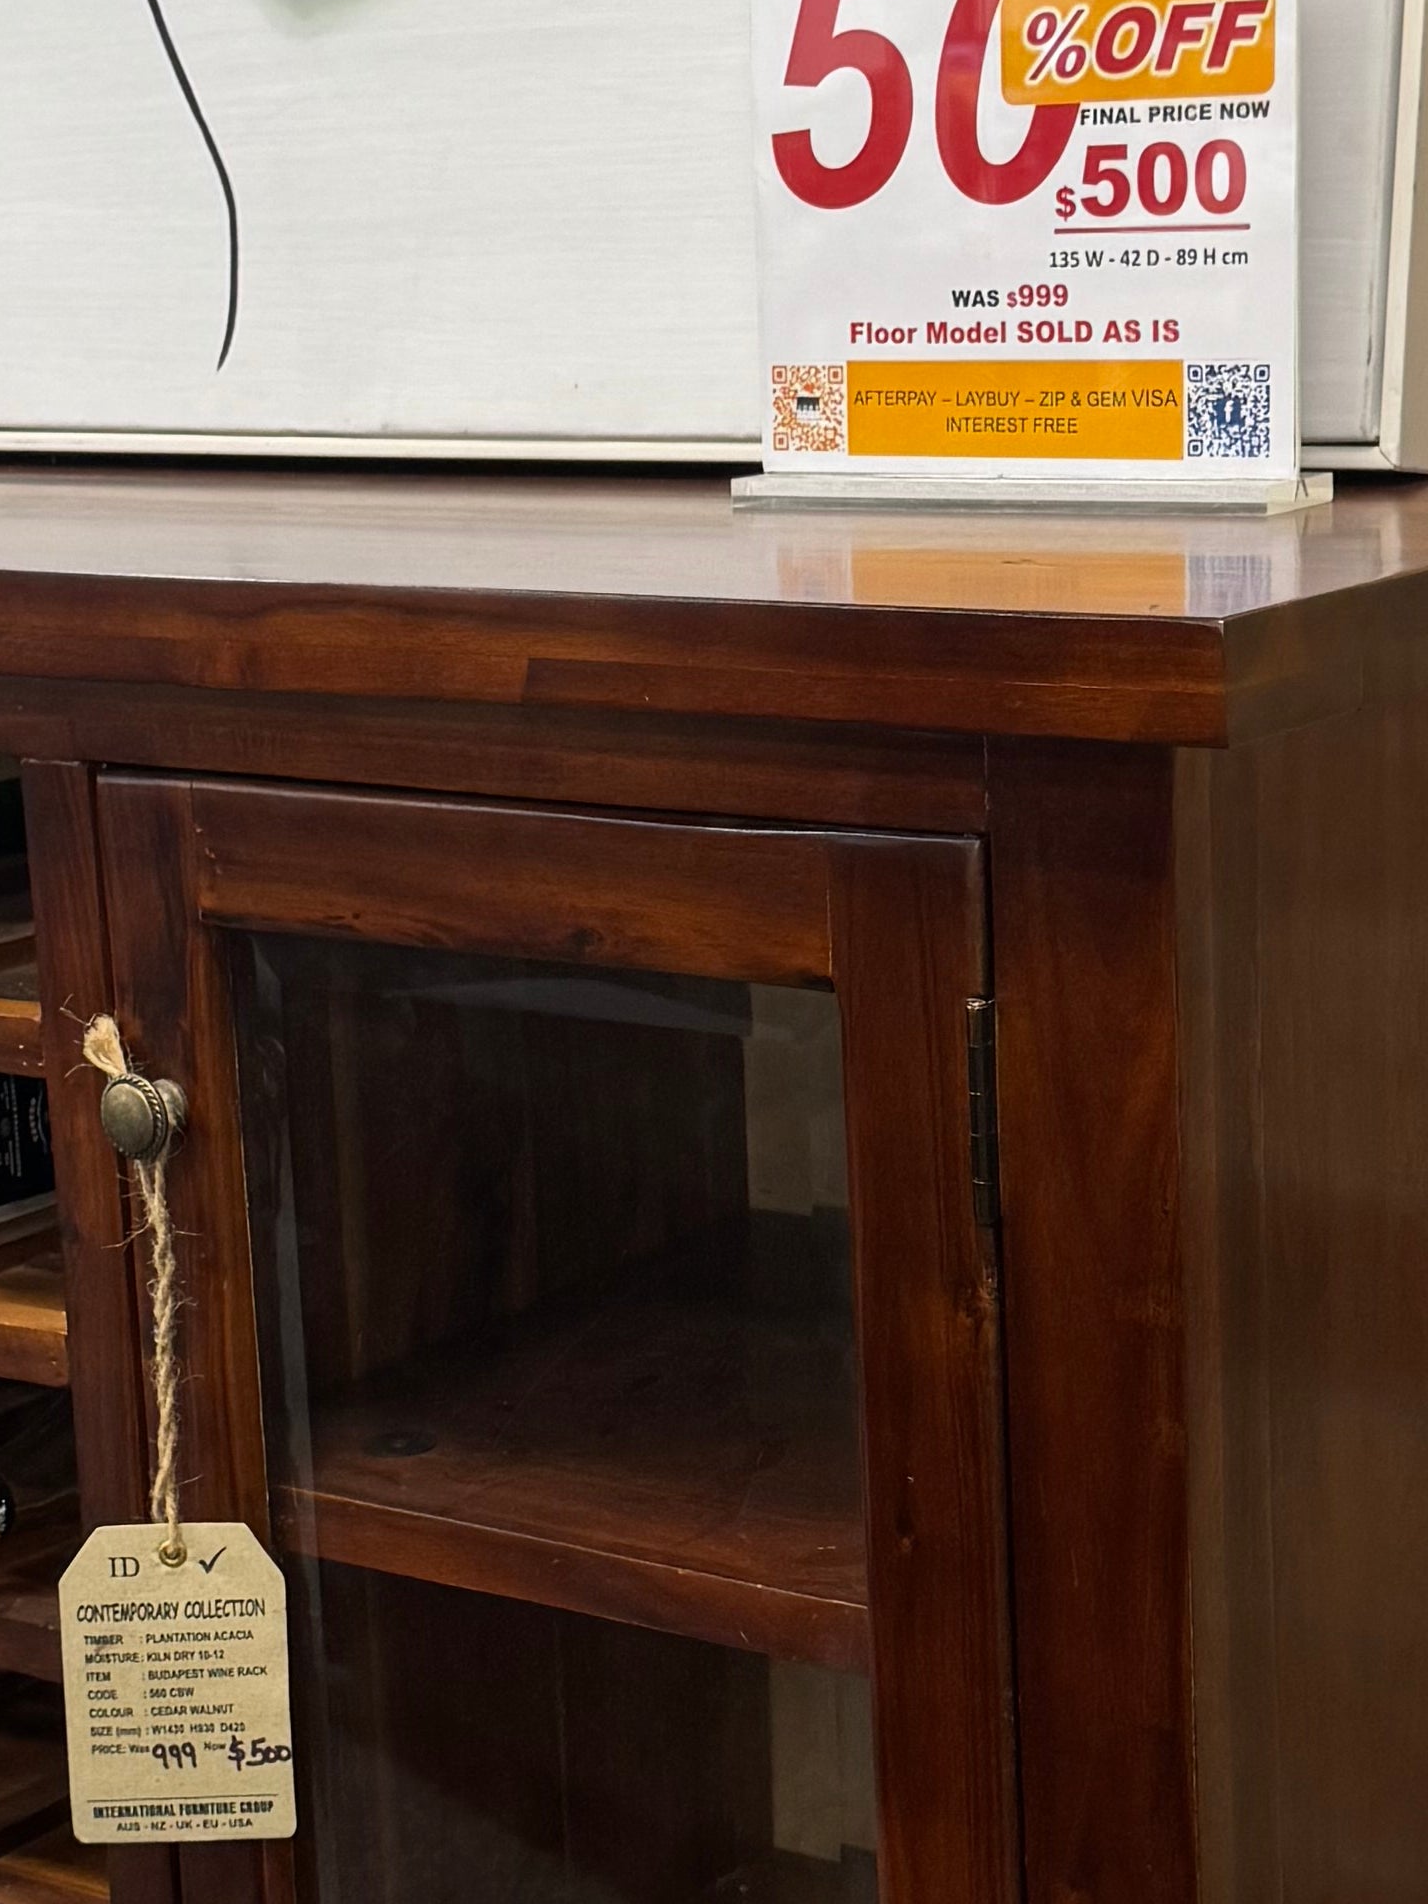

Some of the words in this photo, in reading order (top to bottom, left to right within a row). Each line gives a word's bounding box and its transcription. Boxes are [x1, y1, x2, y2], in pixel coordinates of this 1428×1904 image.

[1080, 106, 1141, 126] FINAL
[1148, 103, 1212, 123] PRICE
[1219, 100, 1271, 121] NOW
[1055, 138, 1247, 222] $500
[1049, 250, 1080, 269] 135
[1085, 249, 1104, 268] W
[1120, 249, 1141, 267] 42
[1146, 249, 1160, 267] D
[1176, 248, 1198, 266] 89
[1203, 247, 1216, 265] H
[1222, 249, 1249, 265] cm
[951, 289, 999, 307] WAS
[1006, 283, 1069, 308] $999
[849, 321, 918, 345] Floor
[926, 321, 1007, 344] Model
[1016, 320, 1093, 344] SOLD
[1103, 320, 1141, 343] AS
[1152, 319, 1180, 342] IS
[853, 389, 937, 407] AFTERPAY
[956, 390, 1020, 407] LAYBUY
[1039, 391, 1066, 408] ZIP
[1071, 391, 1082, 408] &
[1086, 390, 1127, 408] GEM
[1131, 388, 1179, 407] VISA
[946, 417, 1027, 434] INTEREST
[1033, 417, 1078, 434] FREE
[108, 1556, 140, 1578] ID
[77, 1602, 180, 1623] CONTEMPORARY
[184, 1598, 266, 1620] COLLECTION
[84, 1634, 124, 1646] TIMBER
[145, 1632, 211, 1645] PLANTATION
[213, 1630, 254, 1642] ACACIA
[147, 1651, 171, 1663] KILN
[174, 1650, 196, 1662] DRY
[86, 1671, 111, 1683] ITEM
[148, 1668, 204, 1681] BUDAPEST
[208, 1666, 234, 1678] WINE
[237, 1665, 268, 1677] RACK
[87, 1689, 118, 1701] CODE
[89, 1707, 134, 1719] COLOUR
[150, 1705, 189, 1717] CEDAR
[189, 1703, 235, 1715] WALNUT
[90, 1726, 113, 1737] SIZE
[151, 1741, 197, 1770] 999
[204, 1741, 227, 1752] Now
[93, 1803, 176, 1819] INTERNATIONAL
[179, 1802, 237, 1817] FURNITURE
[239, 1800, 274, 1814] GROUP
[116, 1821, 141, 1832] AUS
[151, 1821, 167, 1831] NZ
[176, 1820, 192, 1830] UK
[203, 1819, 219, 1829] EU
[229, 1818, 253, 1829] USA
